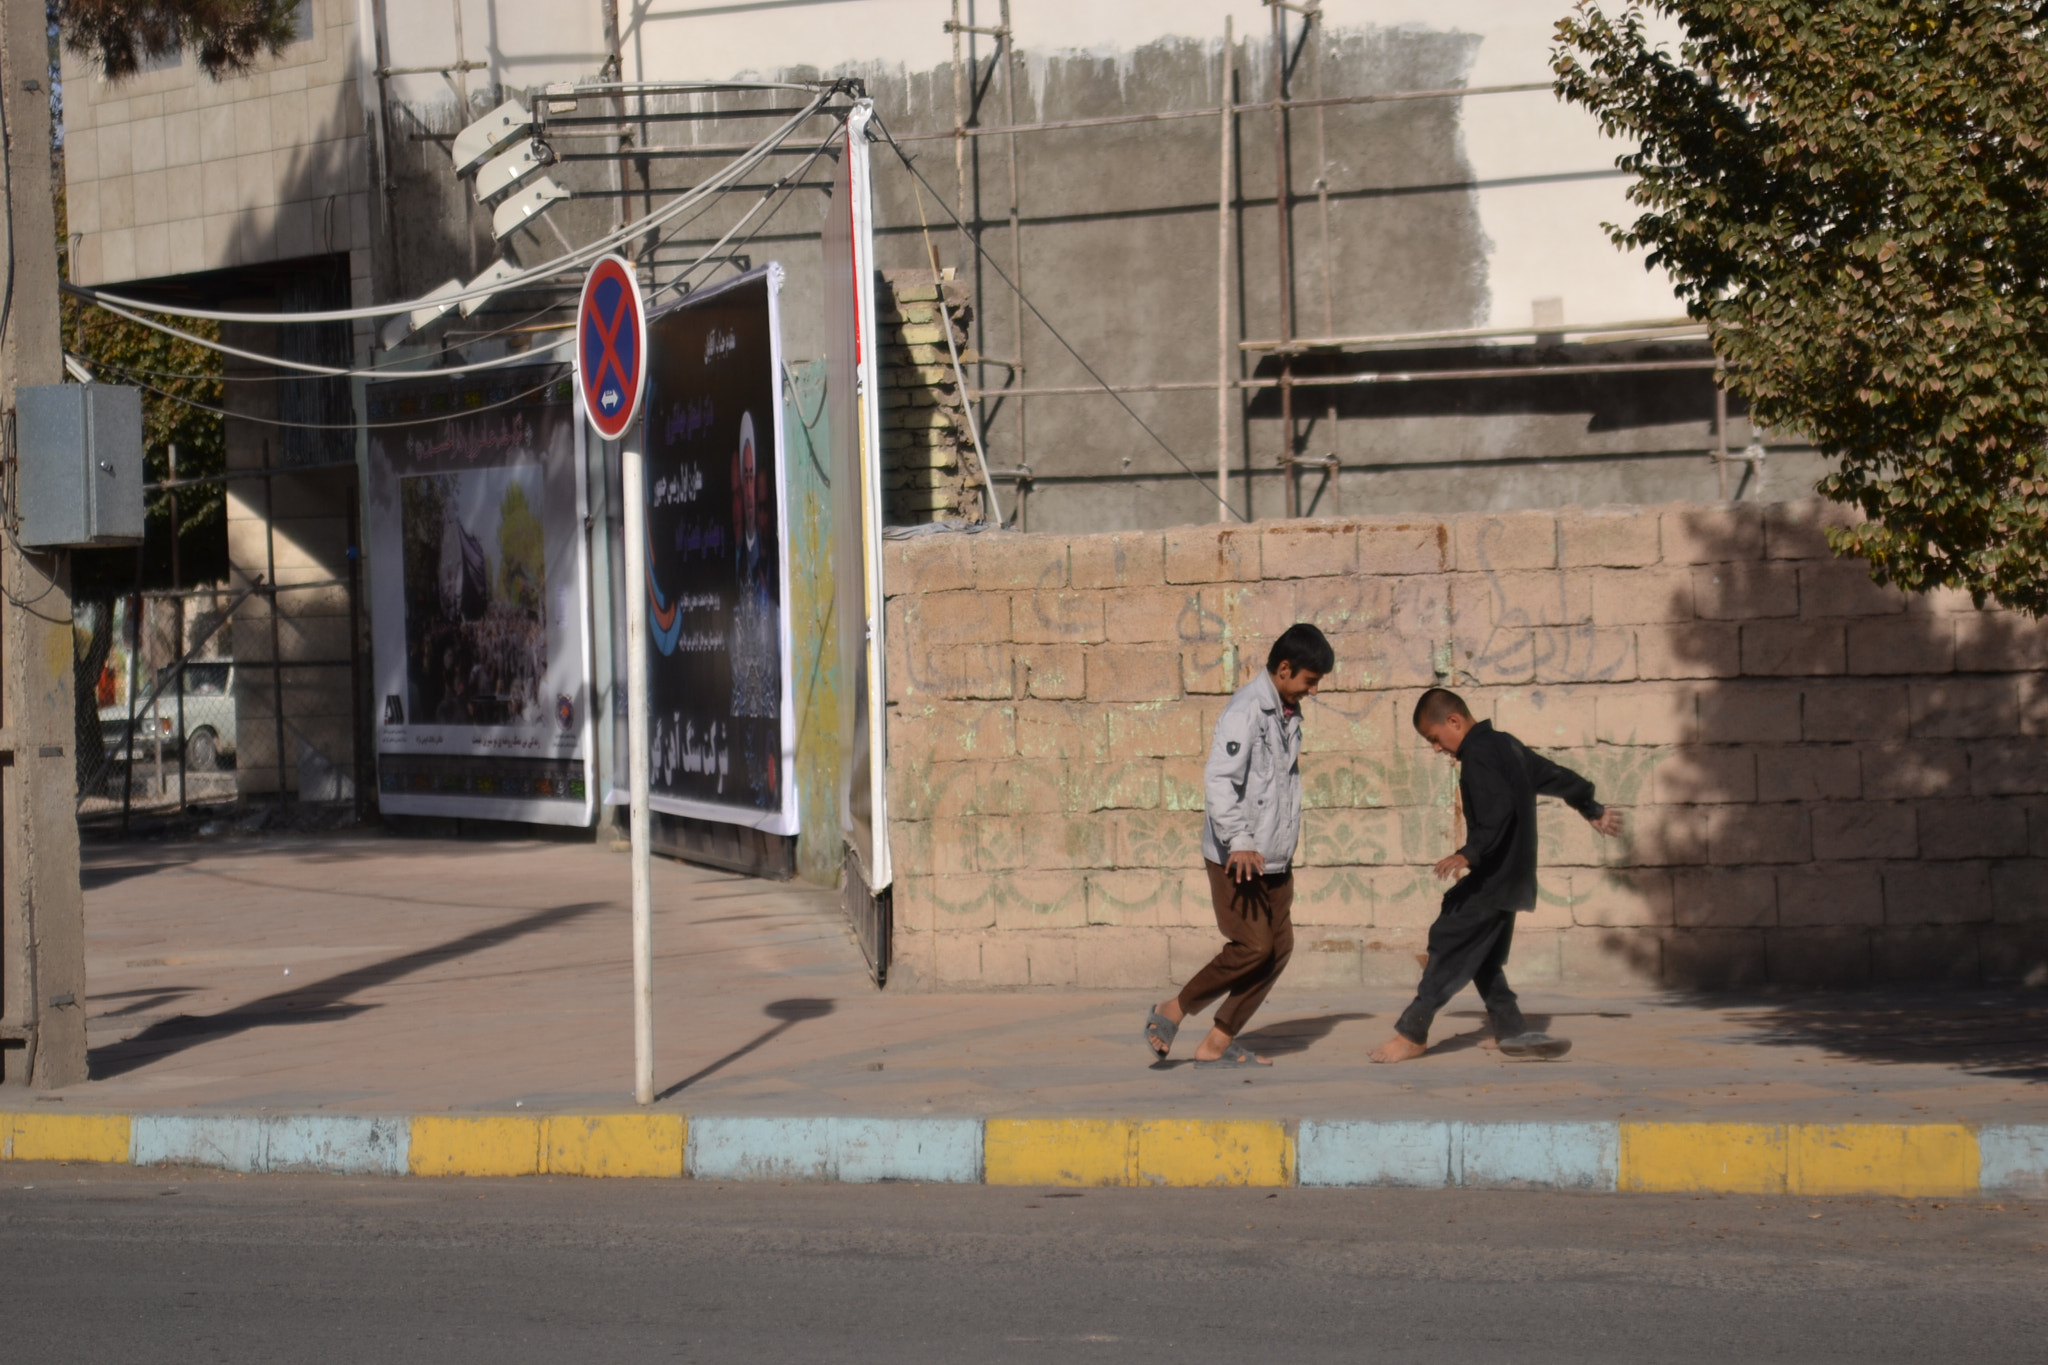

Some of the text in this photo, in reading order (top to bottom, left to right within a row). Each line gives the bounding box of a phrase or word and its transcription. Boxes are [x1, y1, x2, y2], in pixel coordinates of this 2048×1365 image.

[664, 711, 681, 787] آهن
[682, 720, 702, 773] سنگ
[702, 720, 729, 795] شرکت
